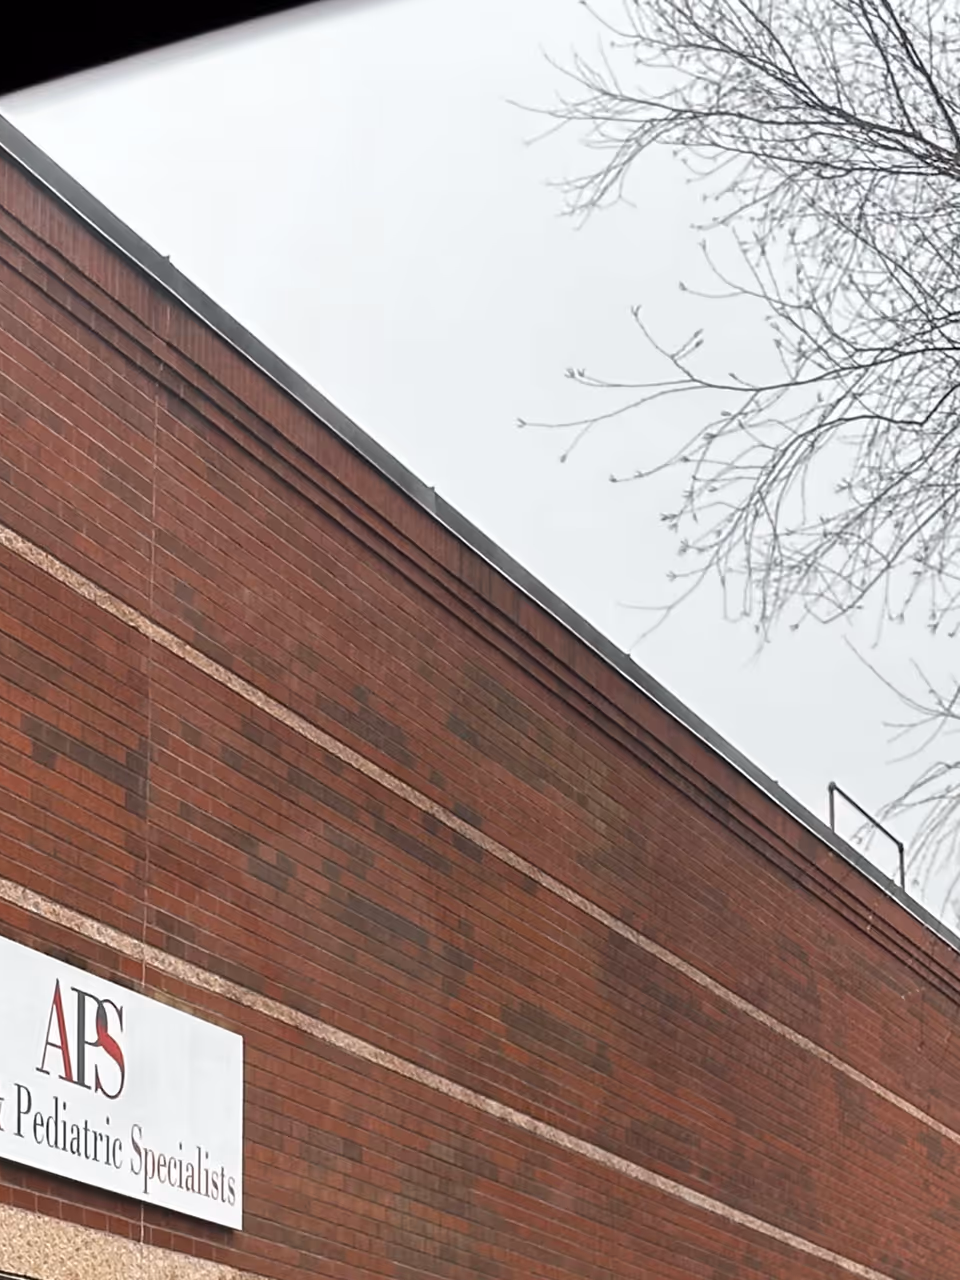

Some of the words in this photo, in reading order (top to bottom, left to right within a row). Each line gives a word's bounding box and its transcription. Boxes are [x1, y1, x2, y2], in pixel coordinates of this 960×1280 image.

[35, 977, 126, 1101] APS
[12, 1082, 123, 1170] Pediatric
[129, 1122, 236, 1207] Specialists
